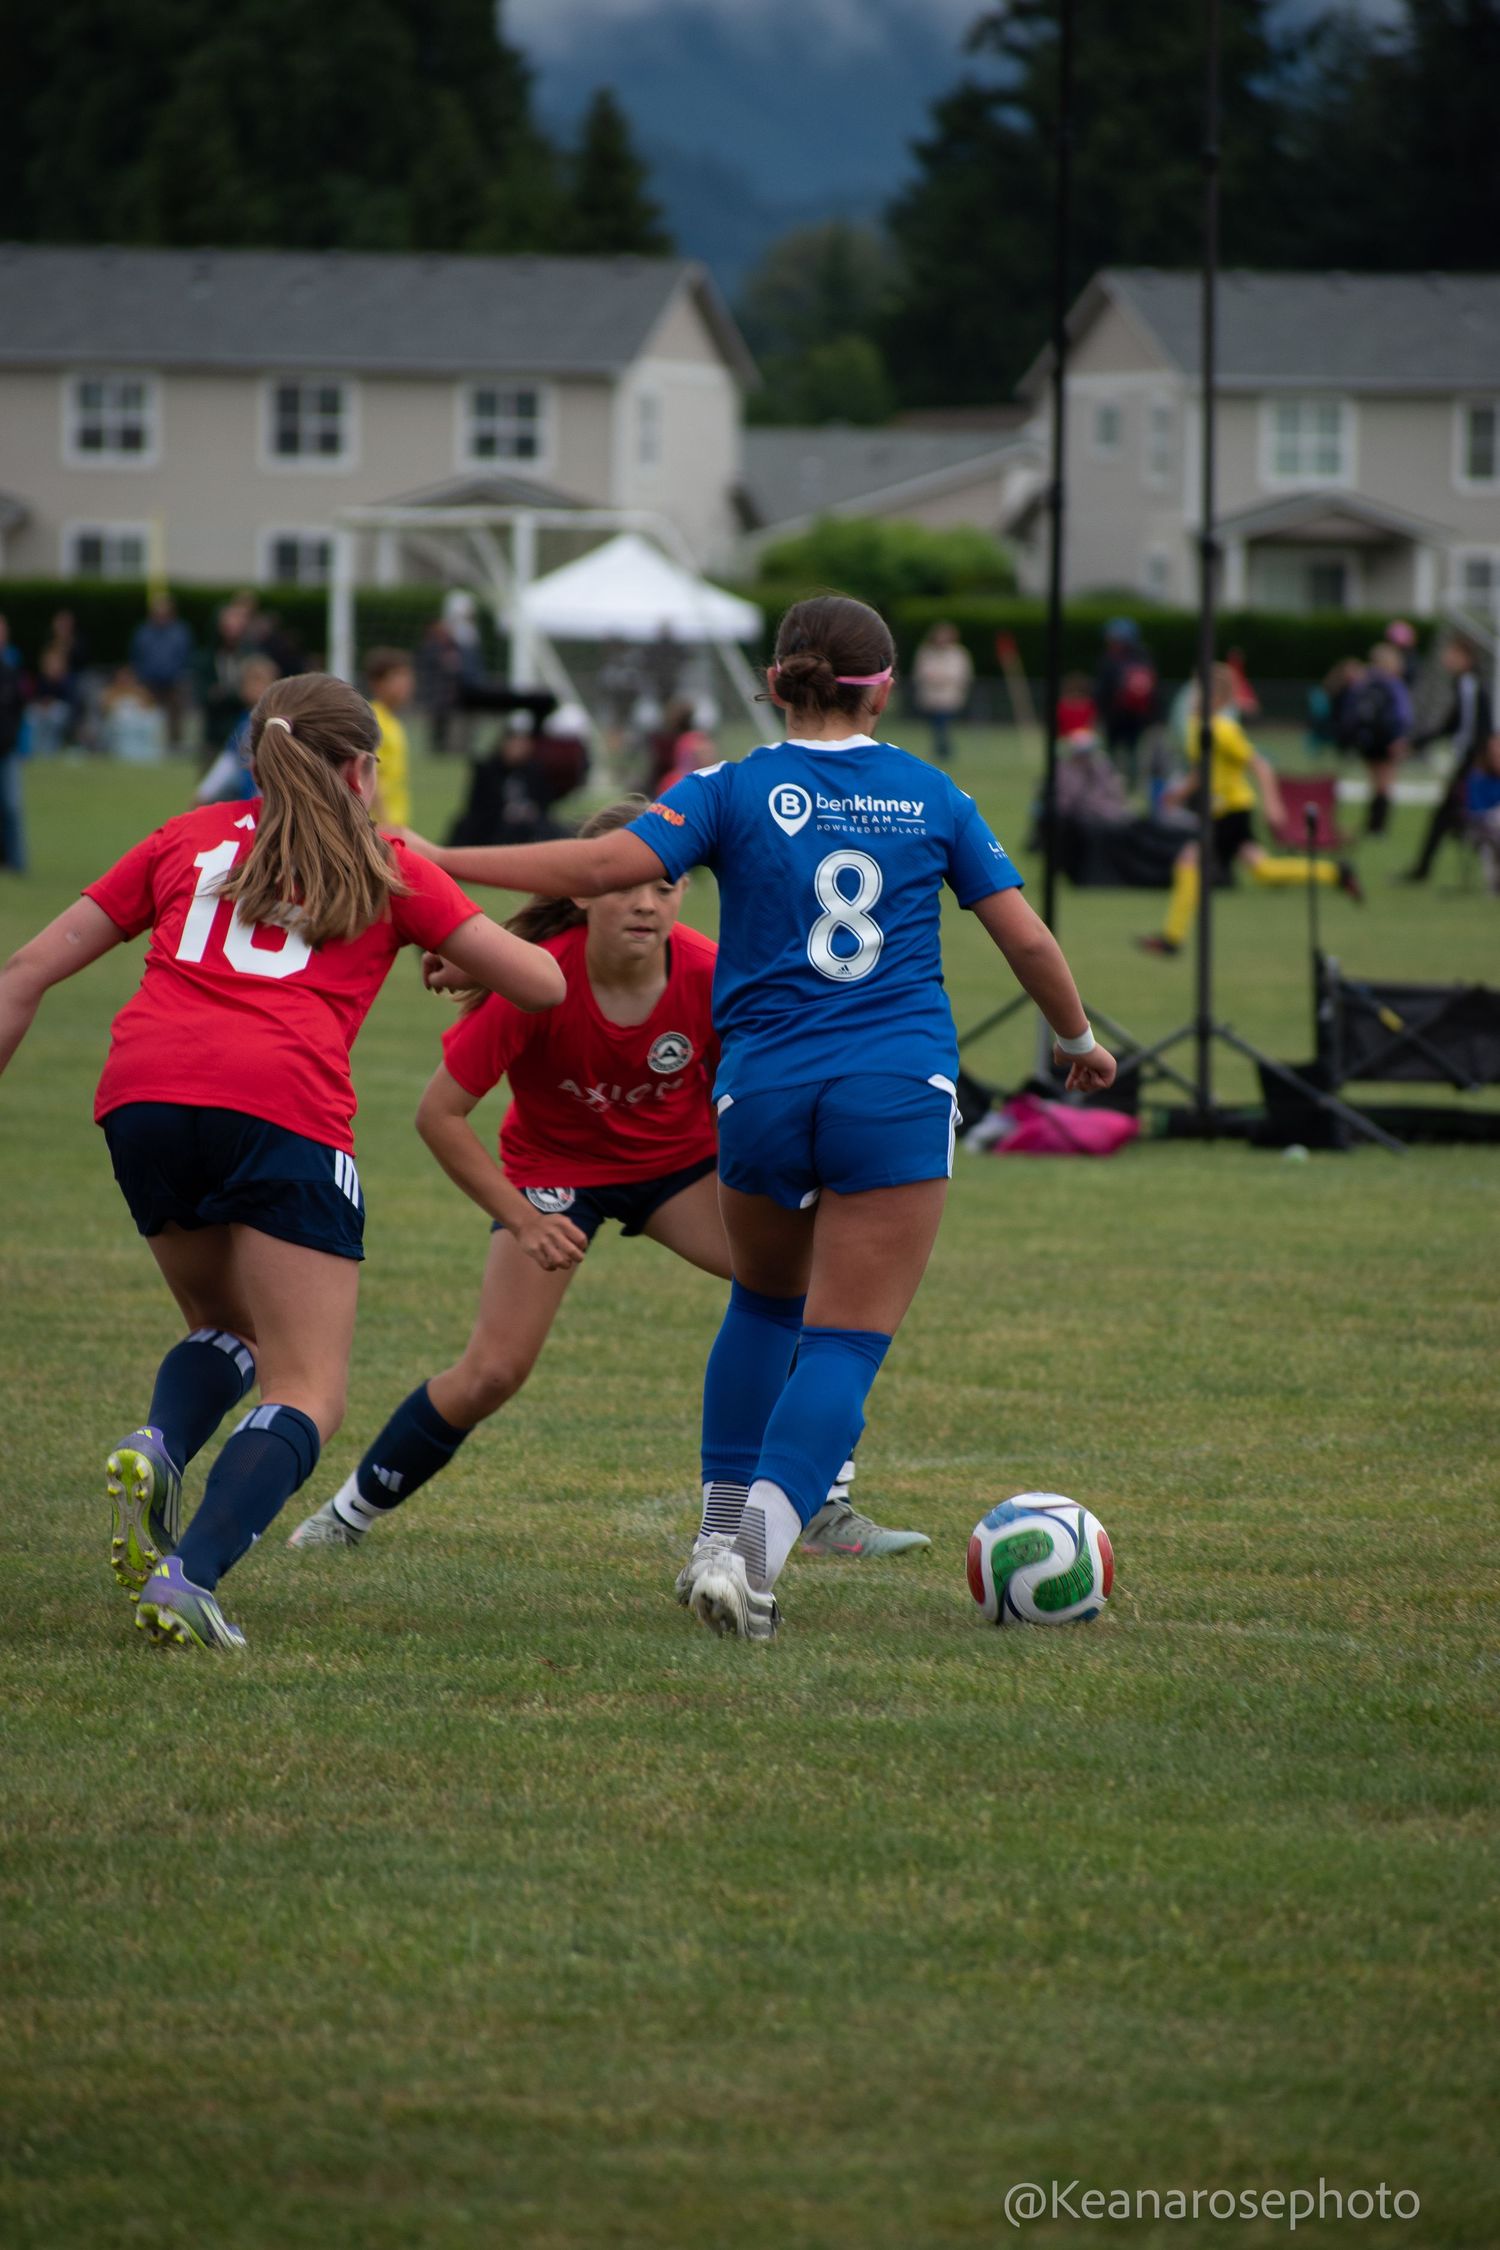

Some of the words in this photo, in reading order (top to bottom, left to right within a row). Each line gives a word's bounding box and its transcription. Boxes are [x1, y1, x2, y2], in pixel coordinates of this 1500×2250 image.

[780, 792, 801, 815] B
[816, 792, 924, 816] benkinney
[816, 824, 871, 834] POWERED
[891, 826, 927, 836] PLACE
[851, 815, 892, 824] TEAM
[807, 849, 884, 982] 8
